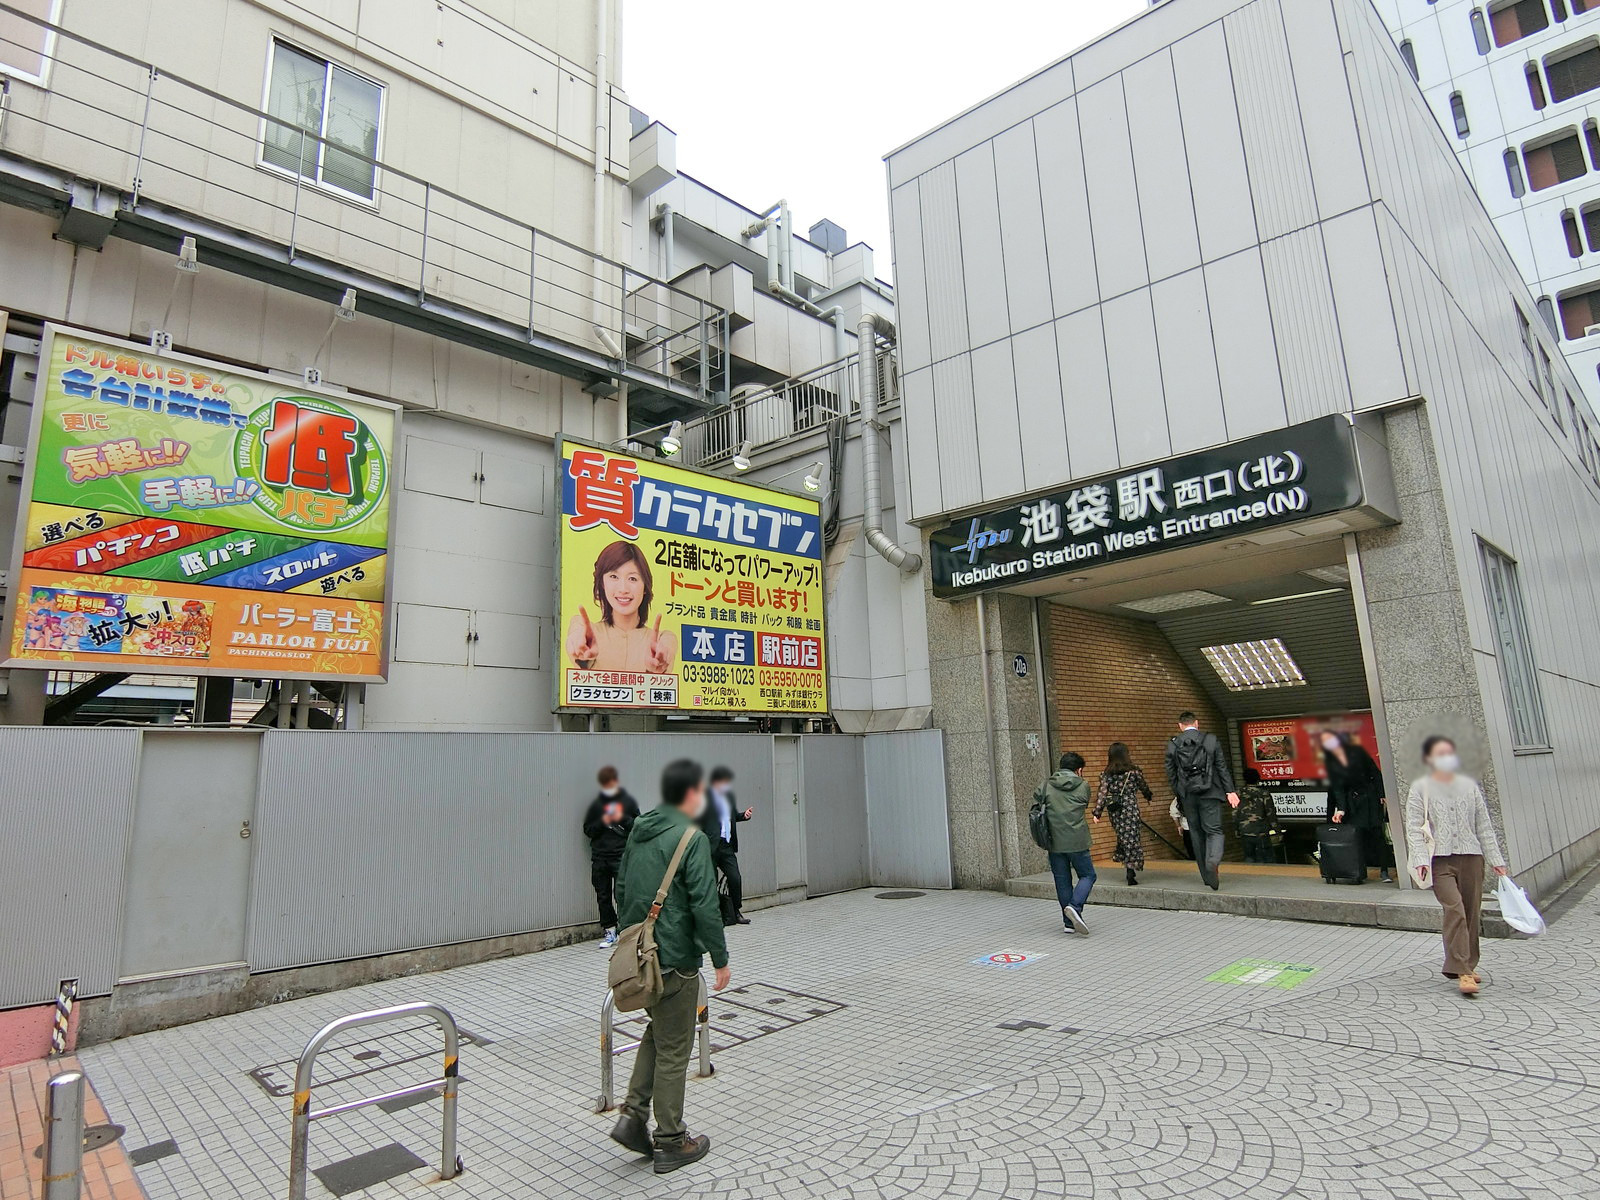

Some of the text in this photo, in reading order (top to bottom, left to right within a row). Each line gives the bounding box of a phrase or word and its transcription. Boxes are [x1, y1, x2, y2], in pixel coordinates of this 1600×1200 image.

[65, 344, 226, 394] ドル箱いらずの
[61, 368, 249, 430] 各台計数機で
[62, 413, 111, 432] 更に
[239, 430, 255, 469] TEIPACHI
[263, 400, 357, 495] 低
[367, 458, 381, 494] TEIPACHI
[278, 490, 348, 525] パチ
[570, 450, 816, 554] 質 クラタセブン
[1019, 467, 1167, 549] 池袋駅
[41, 512, 105, 543] 選べる
[951, 486, 1306, 588] Ikebukuro Station West Entrance(N)
[76, 525, 180, 567] パチンコ
[179, 538, 257, 577] 低パチ
[262, 551, 338, 586] スロット
[320, 566, 365, 594] 遊べる
[240, 602, 361, 634] パーラー富士
[665, 602, 706, 619] ブランド品
[710, 606, 737, 623] 貴金属
[740, 610, 758, 625] 時計
[786, 616, 803, 630] 和服
[805, 618, 821, 632] 絵画
[163, 646, 206, 655] コーナー
[231, 631, 370, 652] PARLOR FUJI
[761, 635, 818, 668] 駅前店
[572, 672, 674, 687] ネットで全国展開中 クリック
[1015, 659, 1027, 674] 20a
[573, 688, 672, 702] クラタセブン で 検索
[1274, 795, 1307, 805] 池袋駅
